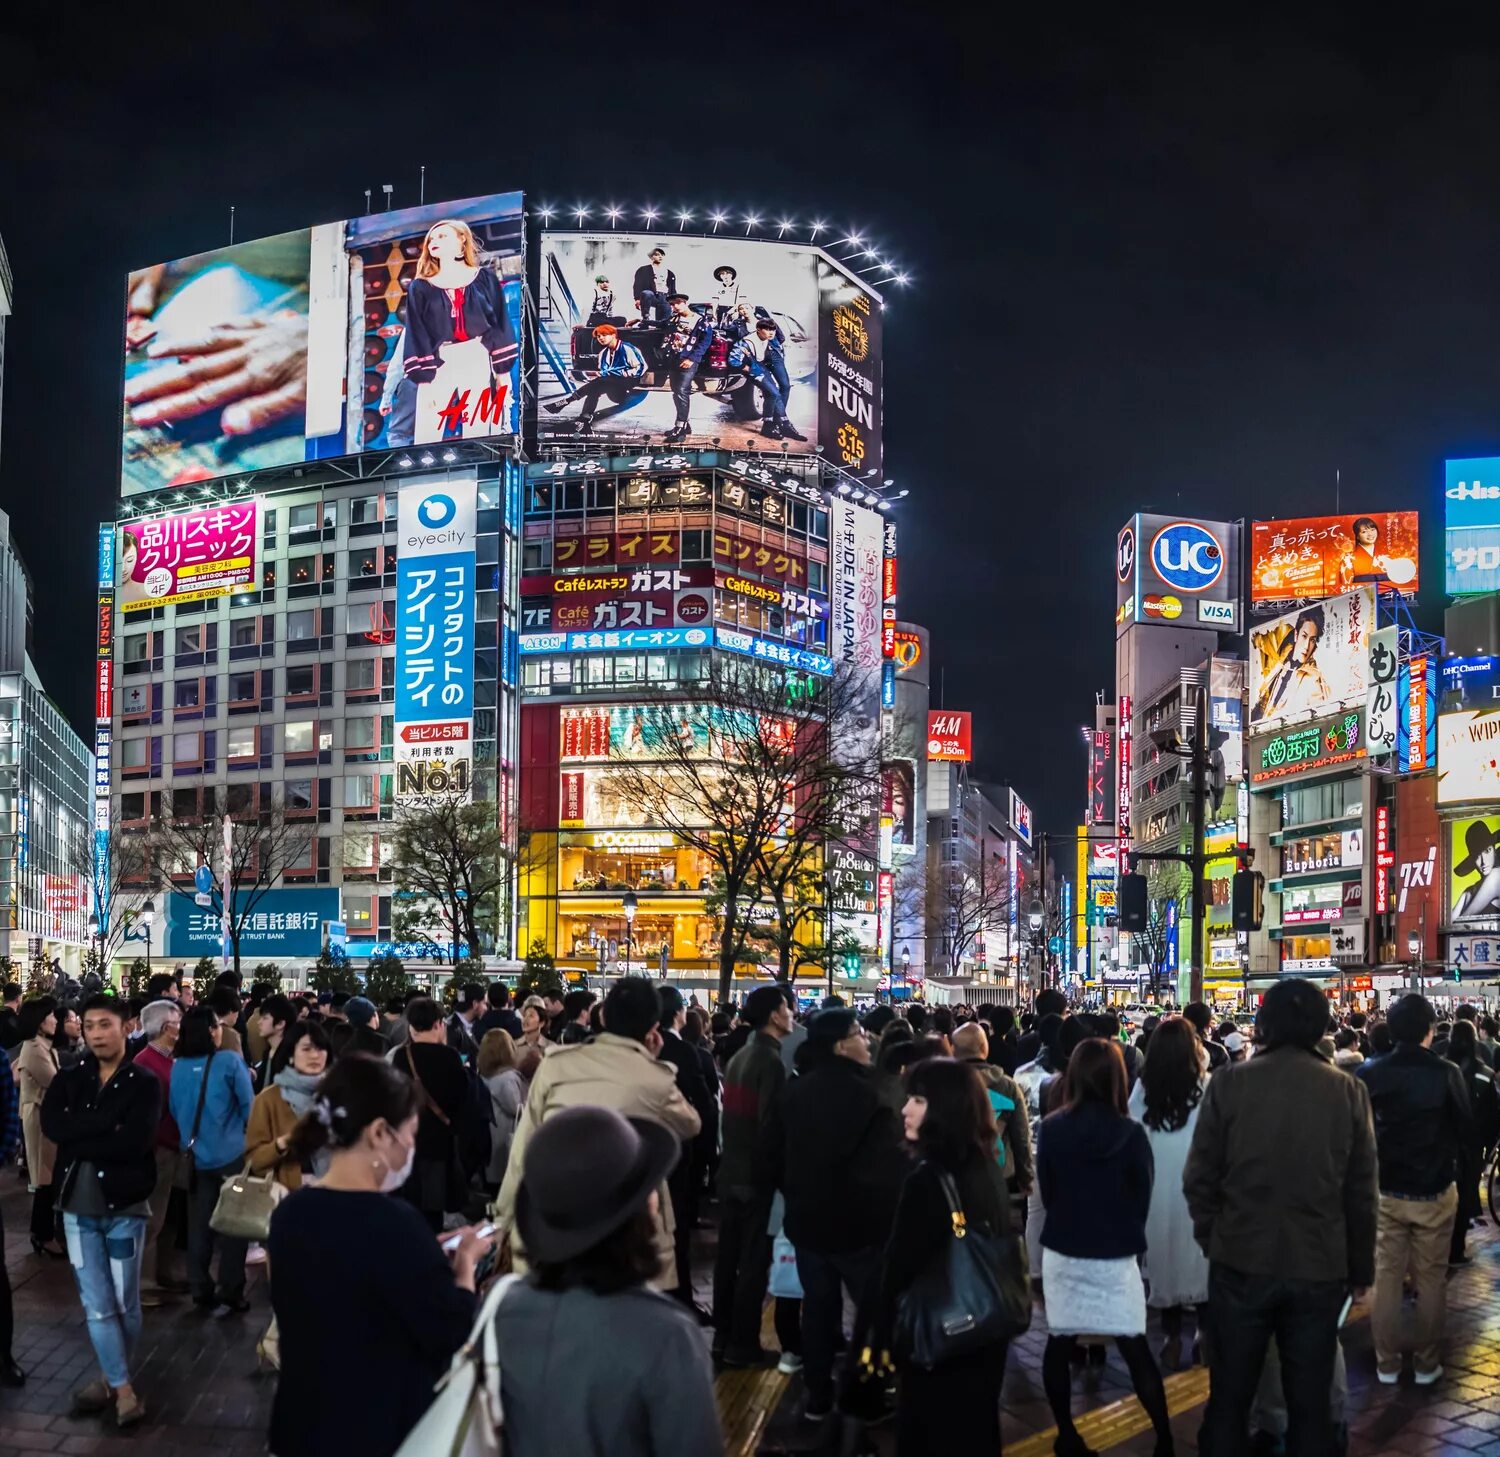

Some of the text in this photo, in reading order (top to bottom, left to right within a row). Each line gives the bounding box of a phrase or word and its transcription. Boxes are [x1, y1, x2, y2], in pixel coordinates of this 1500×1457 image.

[437, 384, 508, 431] H&M
[828, 375, 873, 430] RUN
[838, 427, 865, 459] 3.15
[140, 510, 253, 549] 品川スキン
[407, 530, 466, 549] eyecity
[1268, 525, 1345, 554] 真っ赤って、
[141, 532, 252, 572] クリニック
[556, 535, 675, 560] プライス
[715, 535, 804, 578] コンタクト
[835, 531, 843, 566] ARENA
[1159, 537, 1219, 575] UC
[1256, 547, 1319, 570] ときめき。
[150, 585, 165, 595] 4F
[631, 570, 691, 592] ガスト
[835, 567, 843, 596] TOUR
[557, 605, 590, 620] Café
[593, 600, 666, 629] ガスト
[781, 590, 823, 617] ガスト
[1142, 600, 1184, 613] MasterCard
[1203, 606, 1232, 618] VISA
[524, 608, 551, 626] 7F
[405, 570, 437, 707] アイシティ
[443, 567, 465, 705] コンタクトの
[524, 636, 560, 650] AEON
[572, 631, 680, 648] 英会話イーオン
[1443, 662, 1490, 676] DHC Channel
[1369, 642, 1396, 749] もんじゃ
[409, 726, 464, 740] 当ビル5階
[931, 716, 962, 736] H&M
[411, 746, 455, 757] 利用者数
[942, 746, 965, 756] 150m
[1287, 736, 1320, 762] 西村
[396, 758, 470, 796] No.1
[1095, 732, 1104, 820] KATE
[1286, 855, 1340, 873] Euphoria
[1344, 884, 1361, 902] JTB
[246, 933, 265, 941] TRUST
[267, 932, 286, 940] BANK
